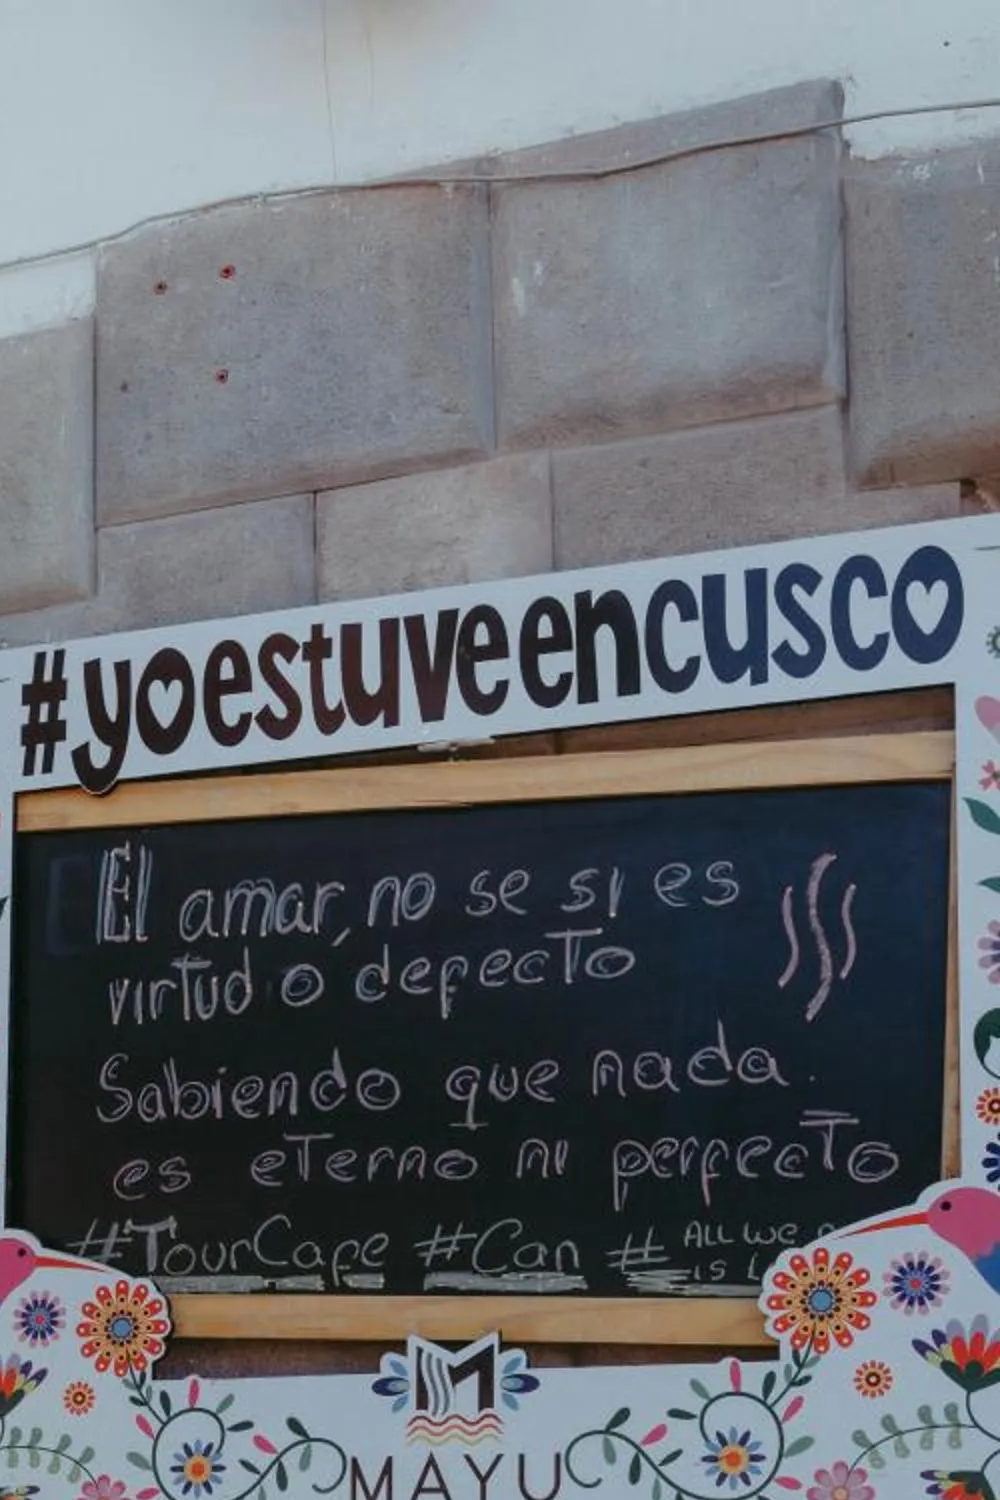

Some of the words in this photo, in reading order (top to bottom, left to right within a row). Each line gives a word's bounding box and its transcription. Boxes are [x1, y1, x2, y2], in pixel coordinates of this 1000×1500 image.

[19, 543, 966, 795] #yoestuveencusco
[96, 841, 153, 945] El
[366, 872, 436, 928] no
[465, 868, 530, 916] se
[653, 859, 741, 908] es
[280, 962, 325, 1008] o
[96, 1045, 401, 1123] Sabiendo
[445, 1057, 561, 1131] que
[112, 1156, 191, 1201] es
